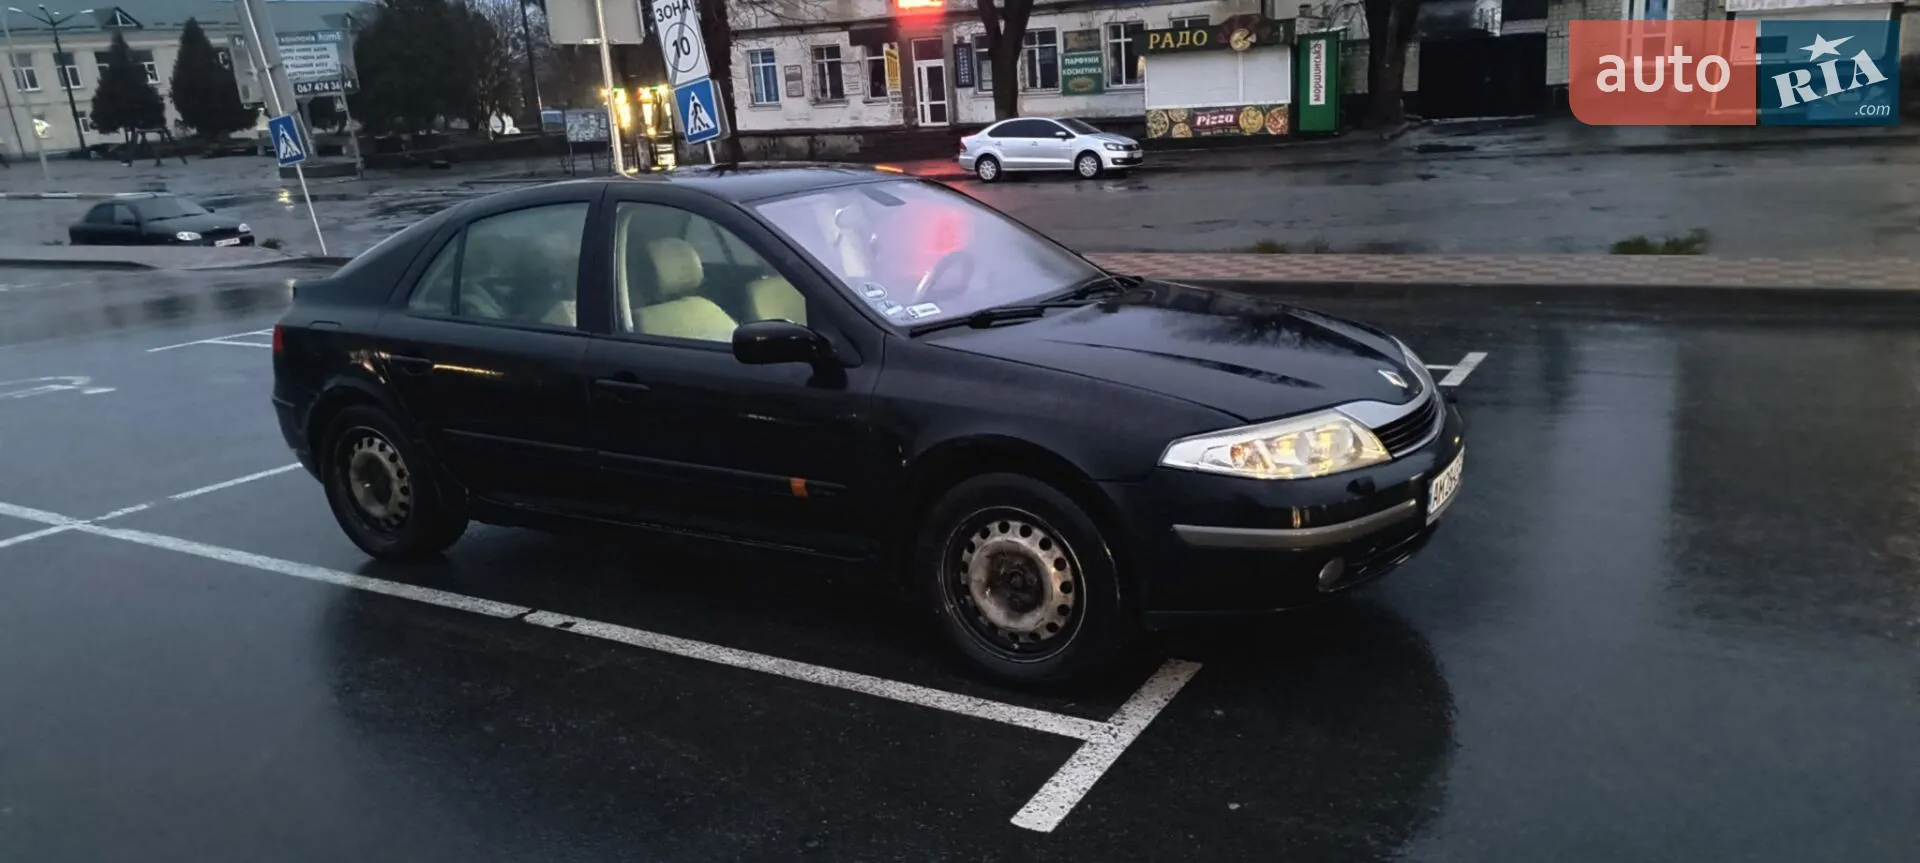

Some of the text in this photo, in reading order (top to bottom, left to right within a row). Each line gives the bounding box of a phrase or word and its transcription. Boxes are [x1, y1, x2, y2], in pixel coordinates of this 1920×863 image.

[656, 0, 691, 22] ЗОНА
[672, 36, 691, 58] 10
[1148, 30, 1208, 49] РАДО
[1062, 67, 1102, 76] КОСМЕТИКА
[1196, 113, 1234, 127] Pizza
